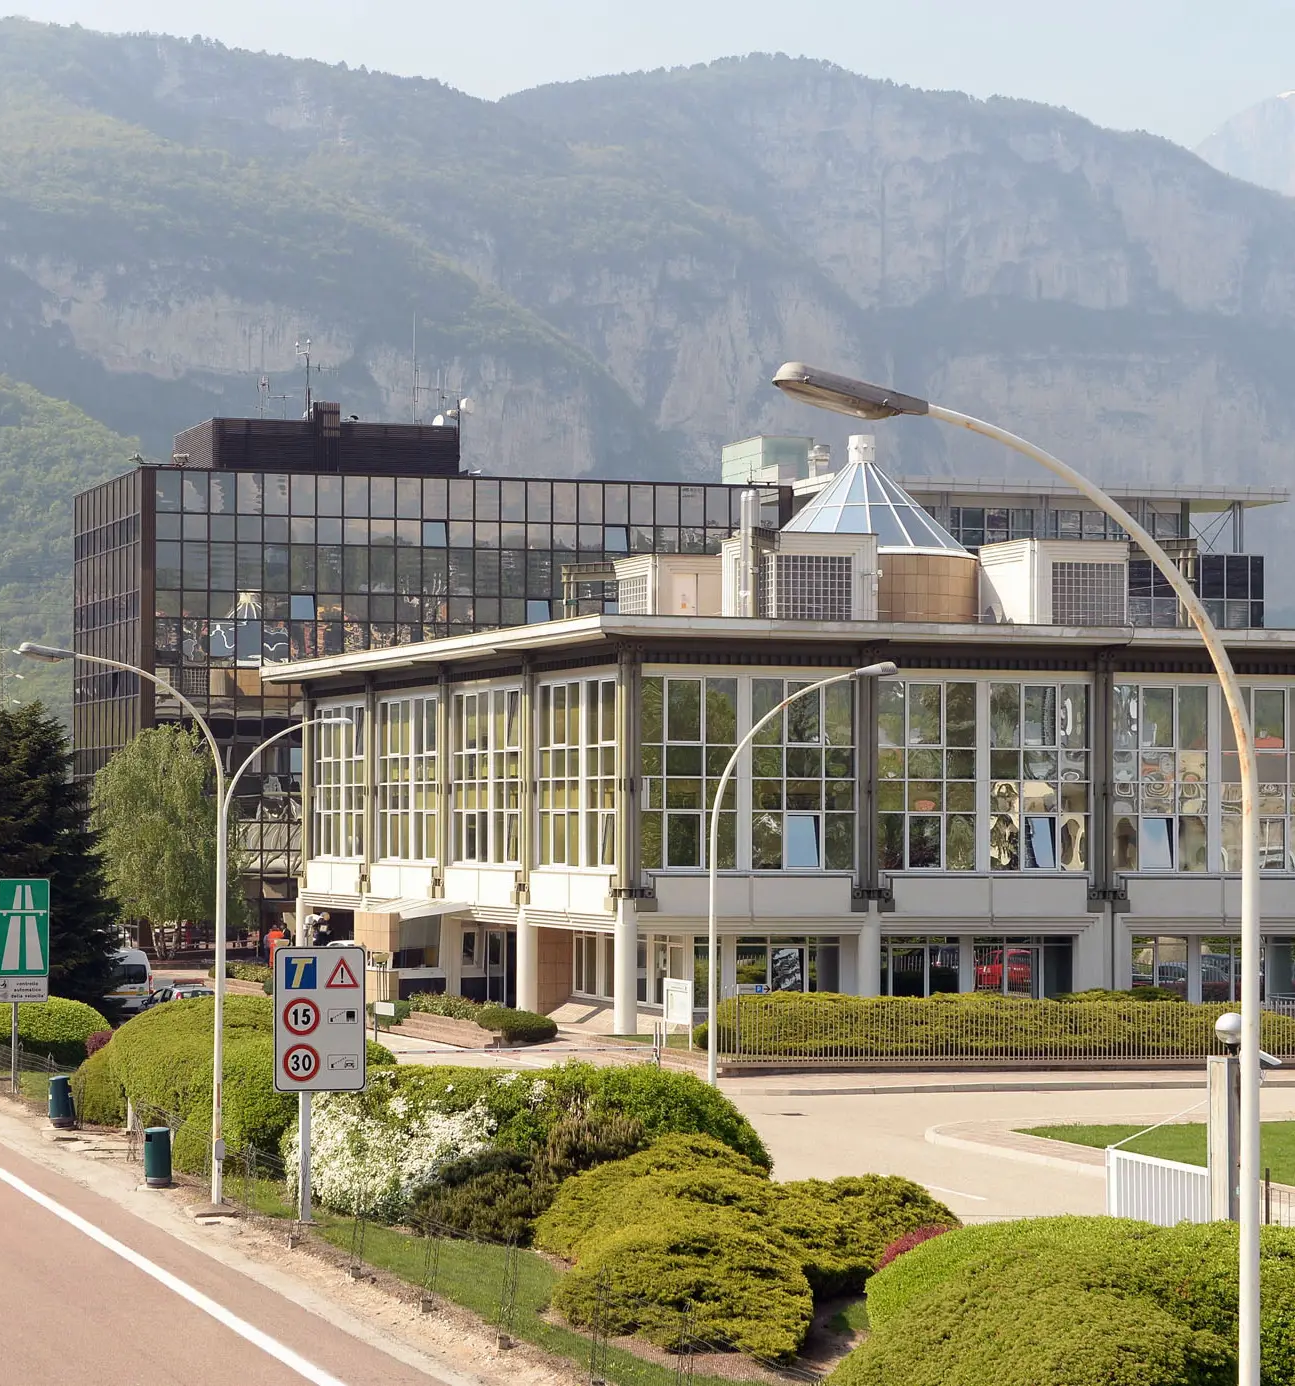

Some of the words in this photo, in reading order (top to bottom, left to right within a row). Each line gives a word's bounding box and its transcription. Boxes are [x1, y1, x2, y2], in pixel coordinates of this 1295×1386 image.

[290, 958, 313, 988] T
[292, 1008, 311, 1026] 15
[291, 1054, 312, 1072] 30
